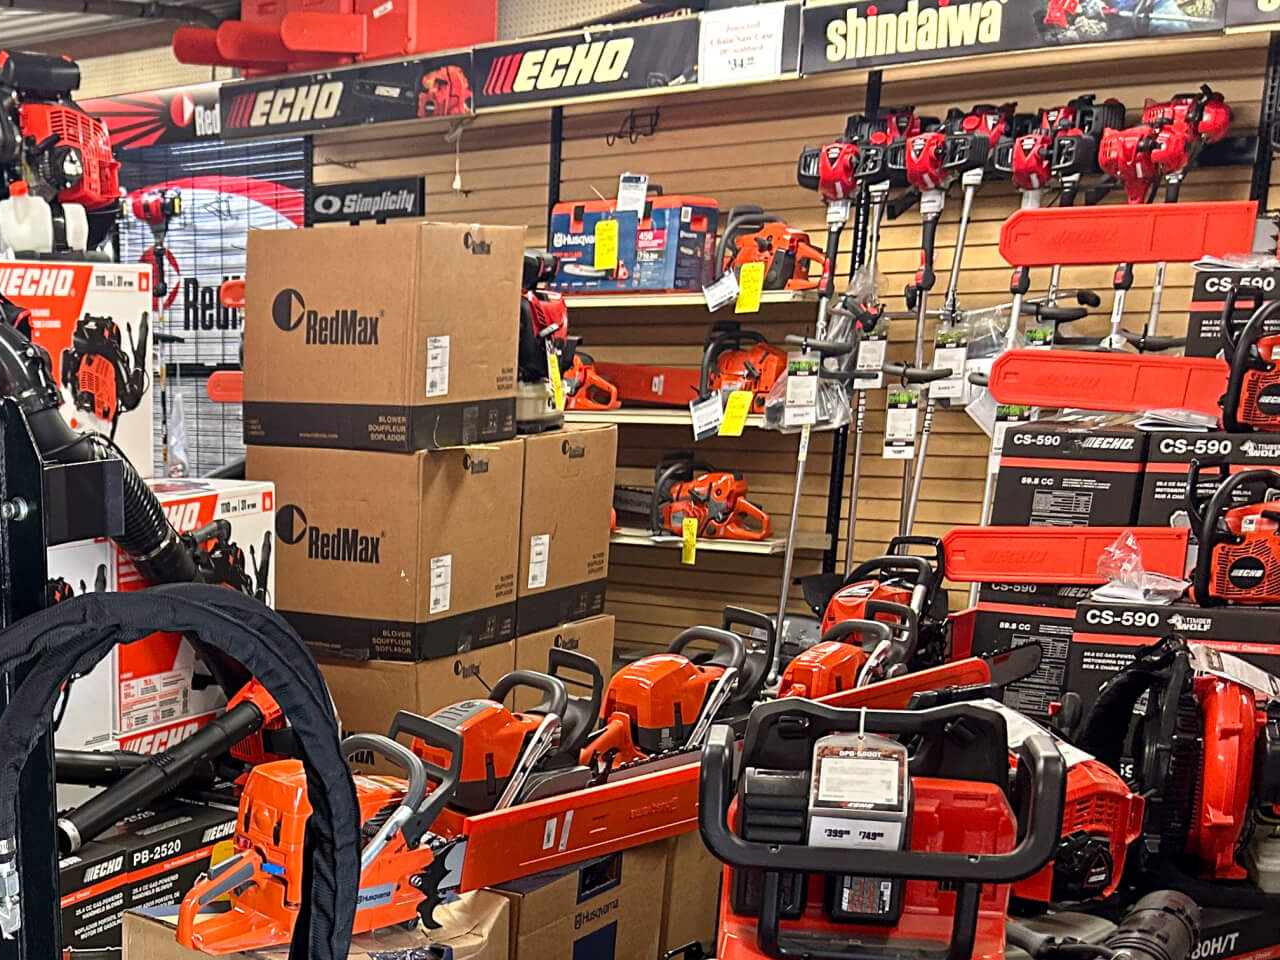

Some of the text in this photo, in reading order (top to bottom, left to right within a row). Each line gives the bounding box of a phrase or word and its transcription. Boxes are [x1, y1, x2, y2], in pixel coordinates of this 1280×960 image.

[826, 0, 1002, 62] shindaiwa
[513, 38, 634, 92] ECHO
[250, 80, 343, 128] ECHO
[343, 189, 414, 215] Simplicity
[6, 269, 74, 296] ECHO
[1205, 277, 1275, 292] CS590
[306, 310, 378, 345] RedMax
[1013, 434, 1134, 450] CS-590 ECHO
[1160, 439, 1232, 454] CS-590
[308, 527, 380, 564] RedMax
[1086, 609, 1160, 627] CS-590
[210, 820, 237, 839] ECHO
[132, 839, 182, 867] PB-2520
[91, 856, 124, 881] ECHO
[583, 899, 619, 924] Husqvarna
